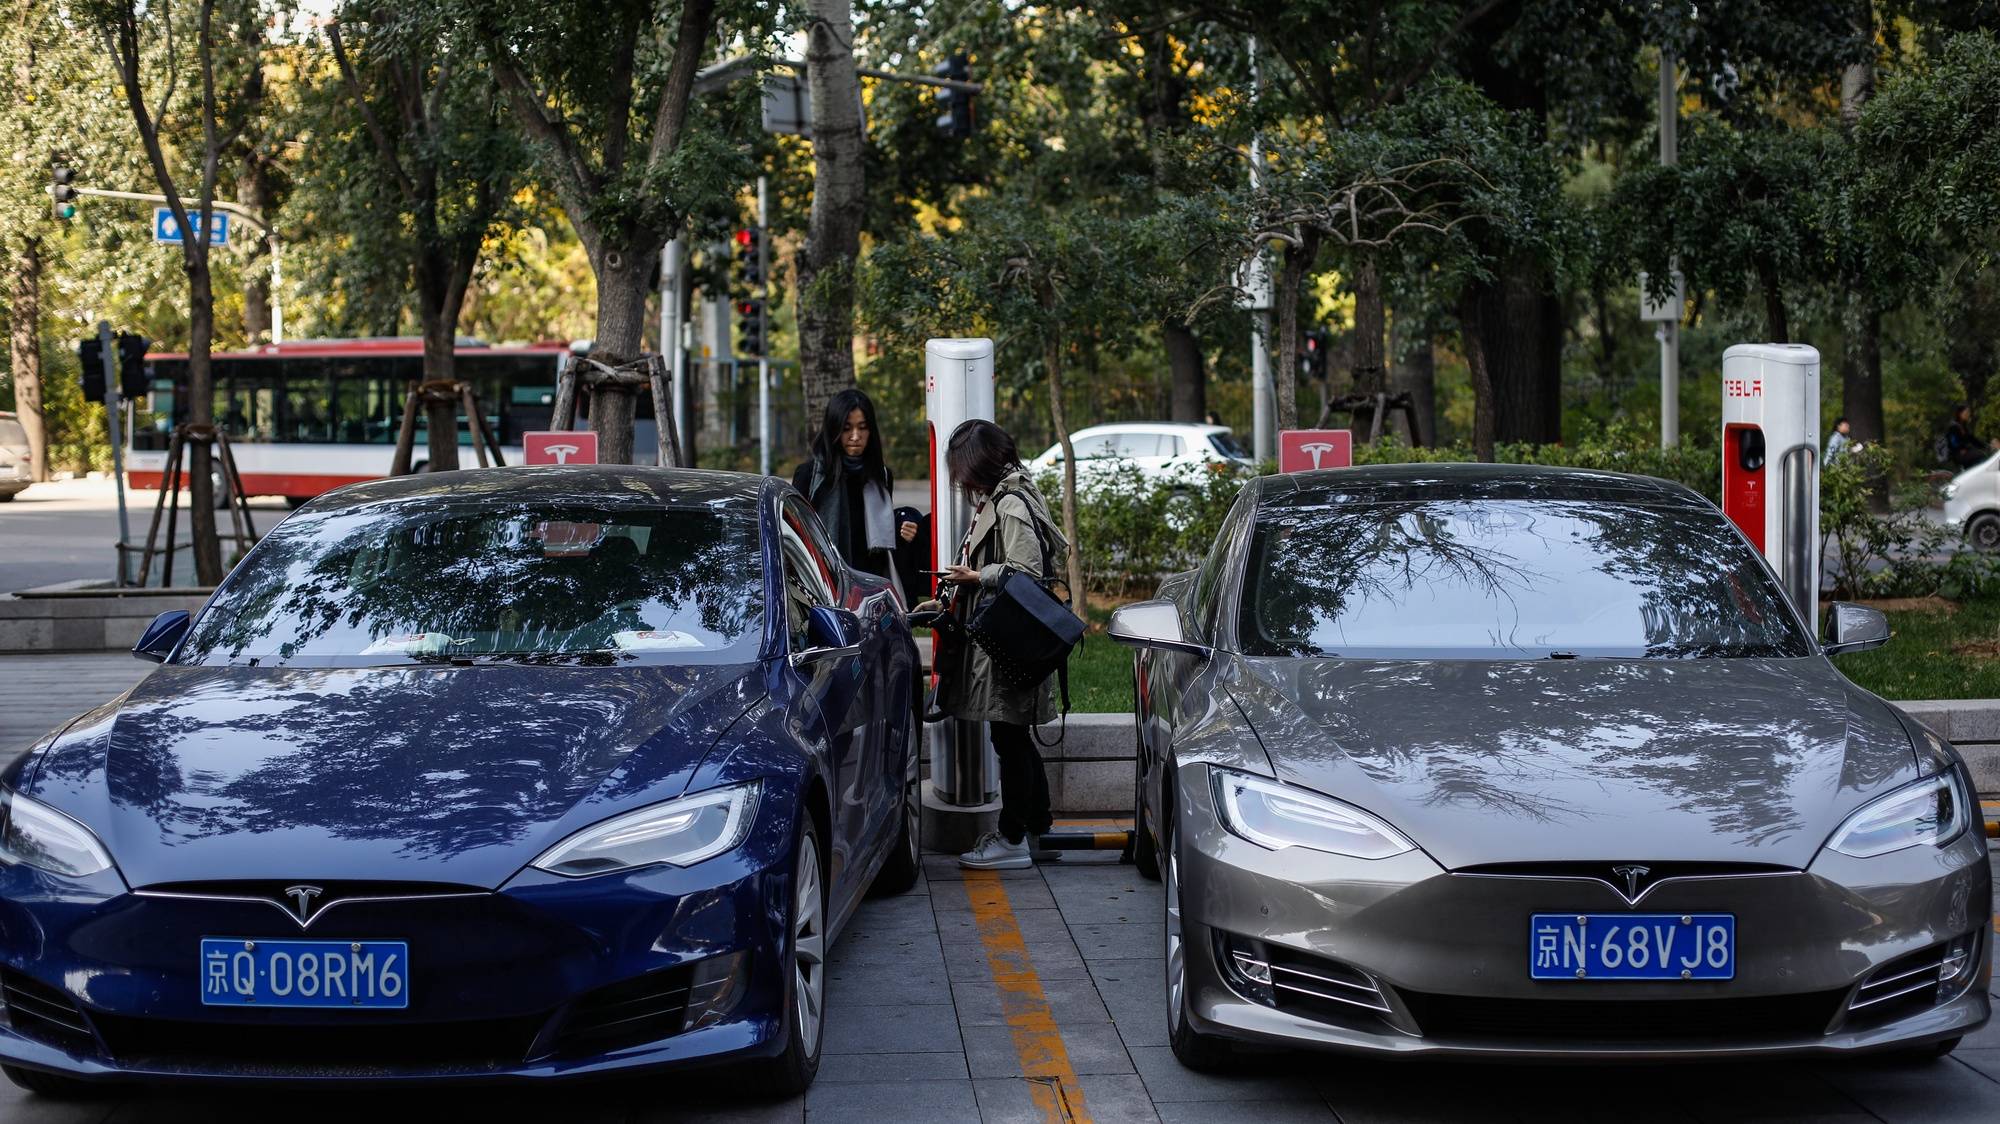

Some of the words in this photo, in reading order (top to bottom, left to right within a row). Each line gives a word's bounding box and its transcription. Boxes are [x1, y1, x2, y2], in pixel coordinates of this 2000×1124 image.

[1724, 380, 1761, 397] TESLA
[1537, 925, 1728, 968] 京N·68VJ8
[206, 950, 401, 997] 京Q·08RM6
